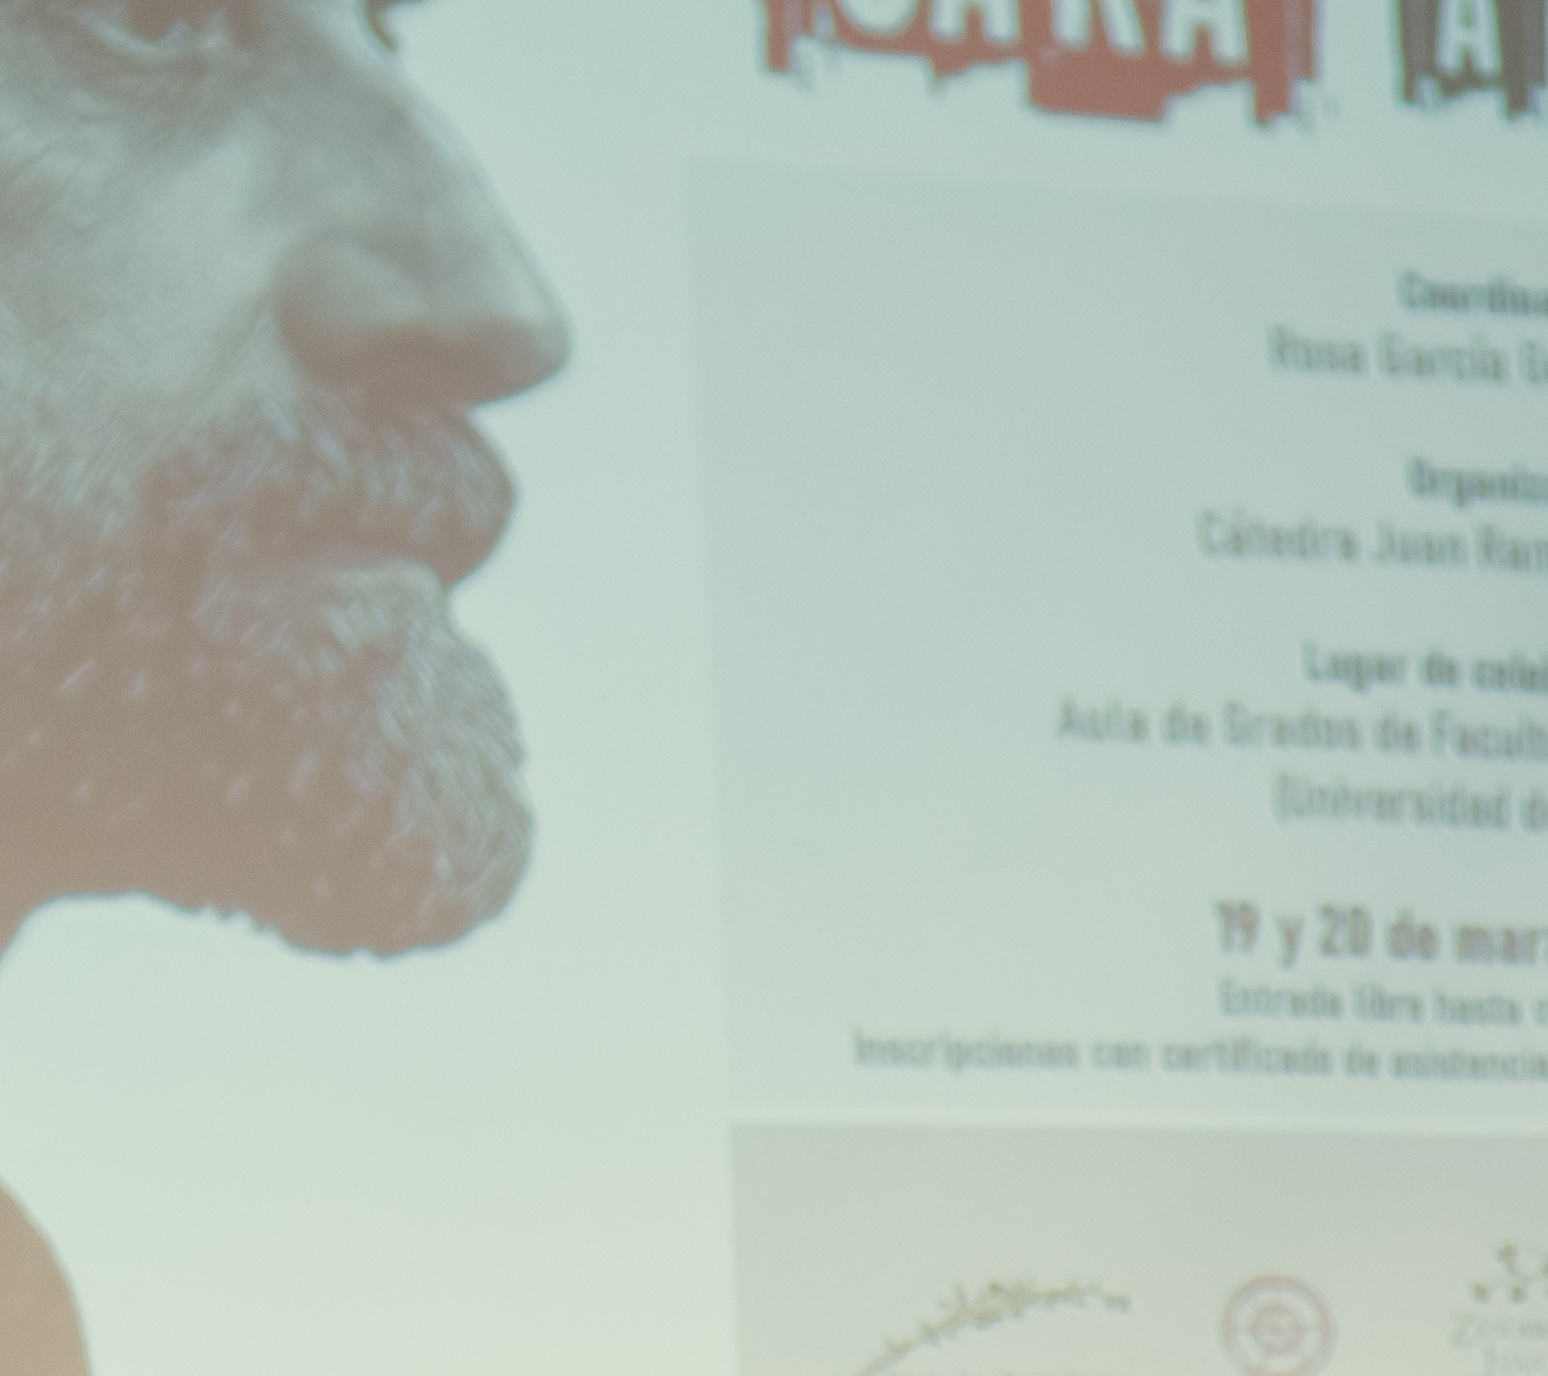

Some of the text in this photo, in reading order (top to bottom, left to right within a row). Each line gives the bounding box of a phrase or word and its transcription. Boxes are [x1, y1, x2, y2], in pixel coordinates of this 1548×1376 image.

[1267, 323, 1364, 374] Rosa
[1377, 331, 1507, 384] García
[1196, 508, 1359, 562] Cátedra
[1372, 519, 1467, 565] Juan
[1302, 637, 1407, 693] Lugar
[1420, 646, 1460, 688] de
[1058, 697, 1147, 742] Aula
[1161, 699, 1210, 747] de
[1224, 701, 1362, 751] Grados
[1371, 708, 1420, 754] de
[1216, 900, 1260, 953] 19
[1276, 915, 1302, 968] y
[1317, 902, 1373, 959] 20
[1385, 912, 1439, 962] de
[1219, 978, 1343, 1019] Entrada
[1353, 982, 1424, 1022] libre
[1432, 985, 1521, 1026] hasta
[852, 1030, 1079, 1075] Inscripciones
[1343, 1040, 1379, 1078] de
